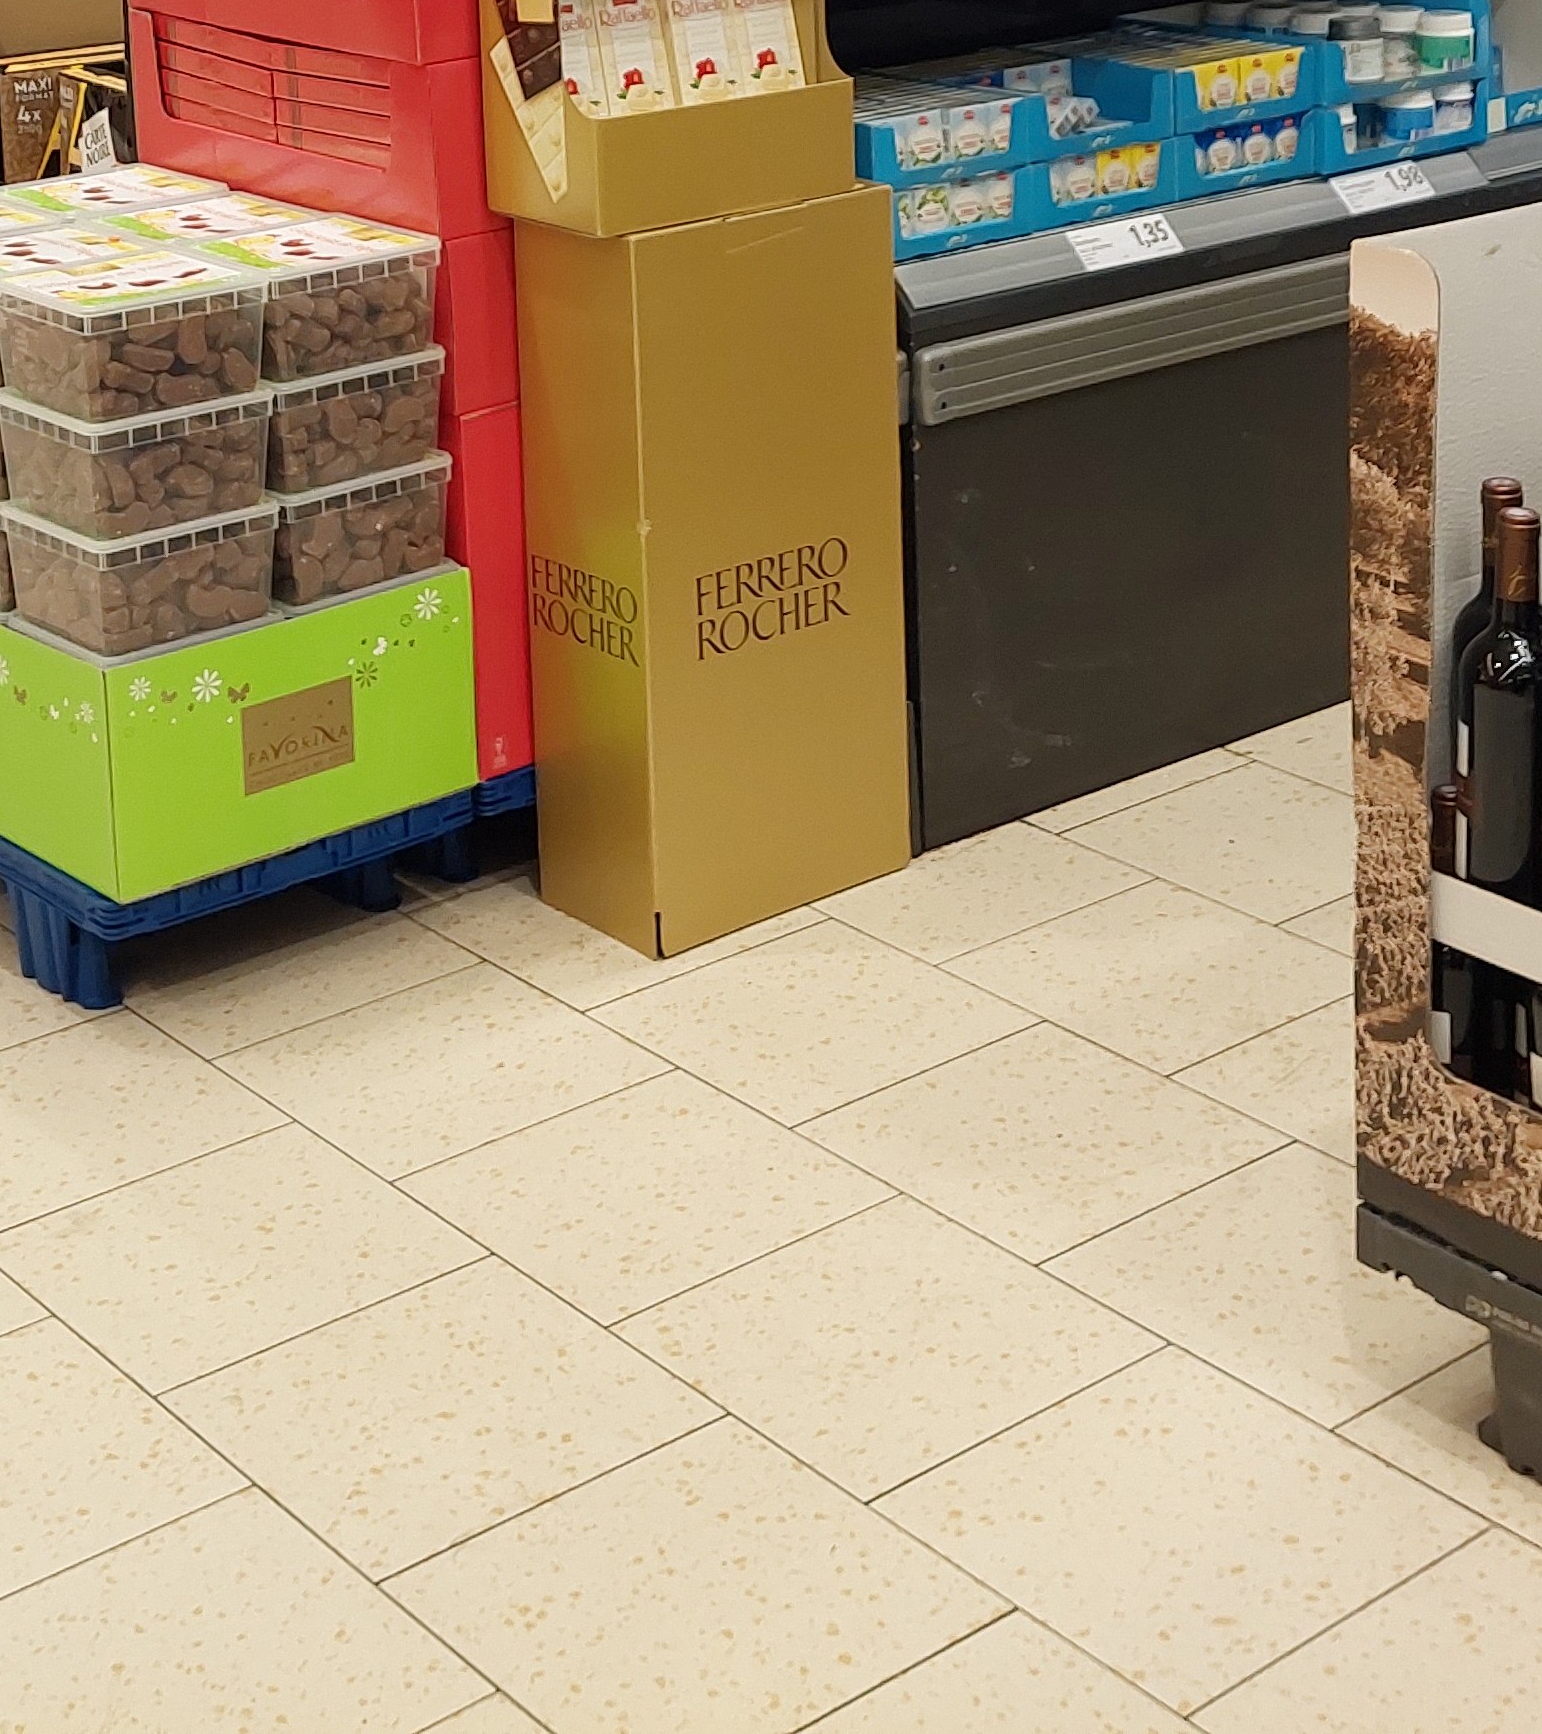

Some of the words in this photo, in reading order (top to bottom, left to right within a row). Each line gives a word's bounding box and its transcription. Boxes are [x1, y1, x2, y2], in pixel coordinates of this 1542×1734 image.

[13, 77, 52, 94] MAXI
[1128, 219, 1170, 248] 1,35
[531, 553, 638, 624] FERRERO
[695, 537, 850, 616] FERRERO
[532, 593, 640, 667] ROCHER
[697, 581, 851, 661] ROCHER
